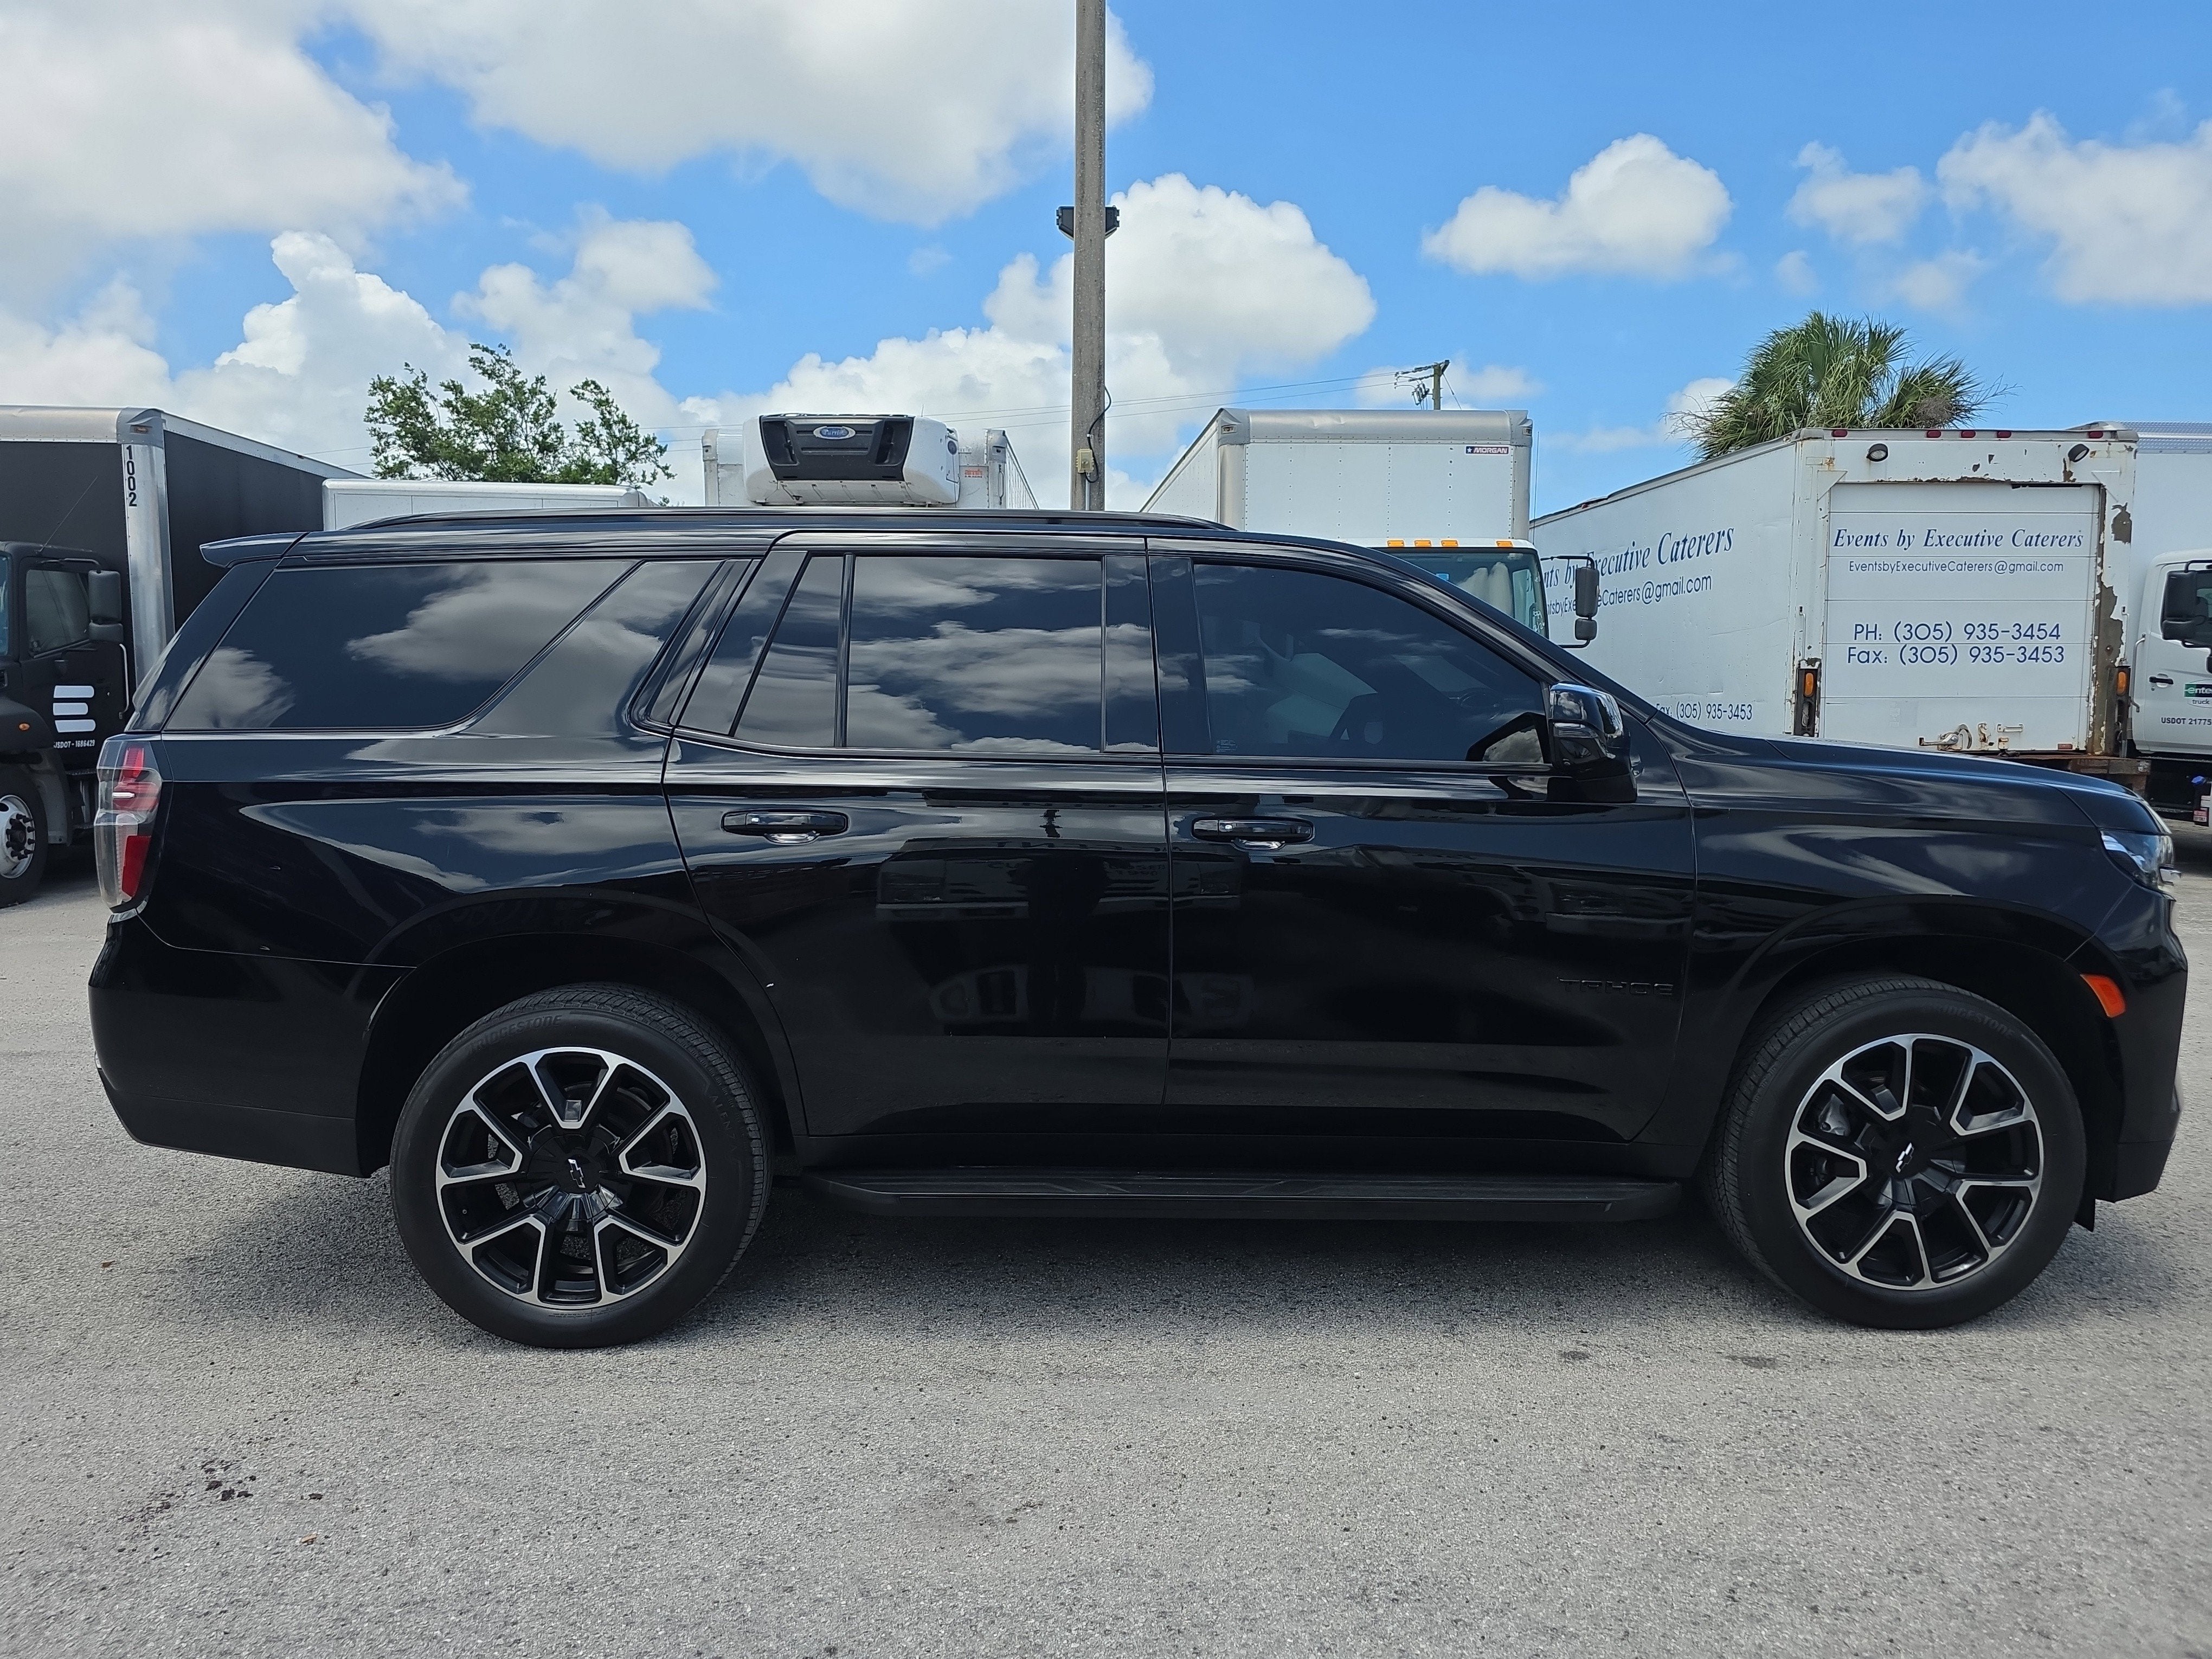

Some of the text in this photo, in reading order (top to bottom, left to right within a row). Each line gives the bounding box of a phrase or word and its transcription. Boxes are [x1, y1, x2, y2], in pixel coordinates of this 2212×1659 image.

[126, 445, 138, 507] 1002
[1658, 528, 1734, 564] Caterers
[1833, 529, 2084, 551] Events by Executive Caterers
[1849, 560, 2064, 575] EventsbyExecutiveCaterers@gmail.com
[1854, 621, 2061, 643] PH: (305) 935-3454
[1848, 644, 2064, 666] Fax: (305) 935-3453
[1676, 701, 1701, 721] (305)
[1706, 703, 1752, 720] 935-3453
